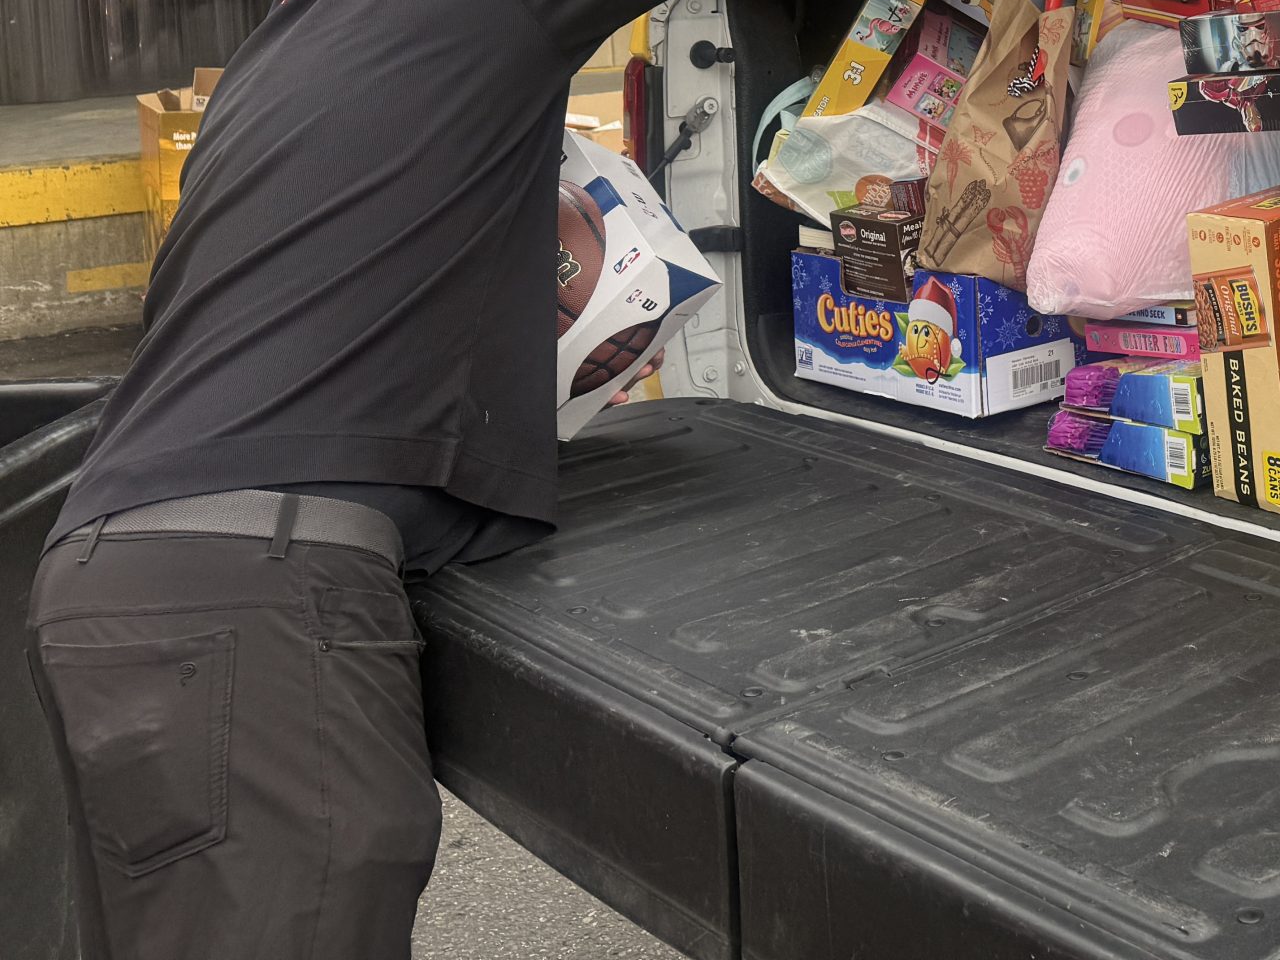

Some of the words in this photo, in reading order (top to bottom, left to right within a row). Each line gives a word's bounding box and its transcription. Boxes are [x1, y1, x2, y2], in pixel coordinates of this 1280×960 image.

[173, 132, 190, 141] More
[861, 228, 886, 242] Original
[817, 292, 894, 341] Cuties
[1150, 309, 1166, 320] SEEK
[1208, 289, 1218, 311] BAKED
[1215, 312, 1223, 335] BEANS
[1220, 285, 1239, 337] Original
[1235, 283, 1258, 332] BUSH'S
[1048, 349, 1054, 357] 21
[1122, 332, 1161, 352] GLITTER
[1164, 336, 1182, 354] FUN
[1229, 358, 1244, 423] BAKED
[1235, 430, 1250, 496] BEANS
[1267, 468, 1278, 499] CANS
